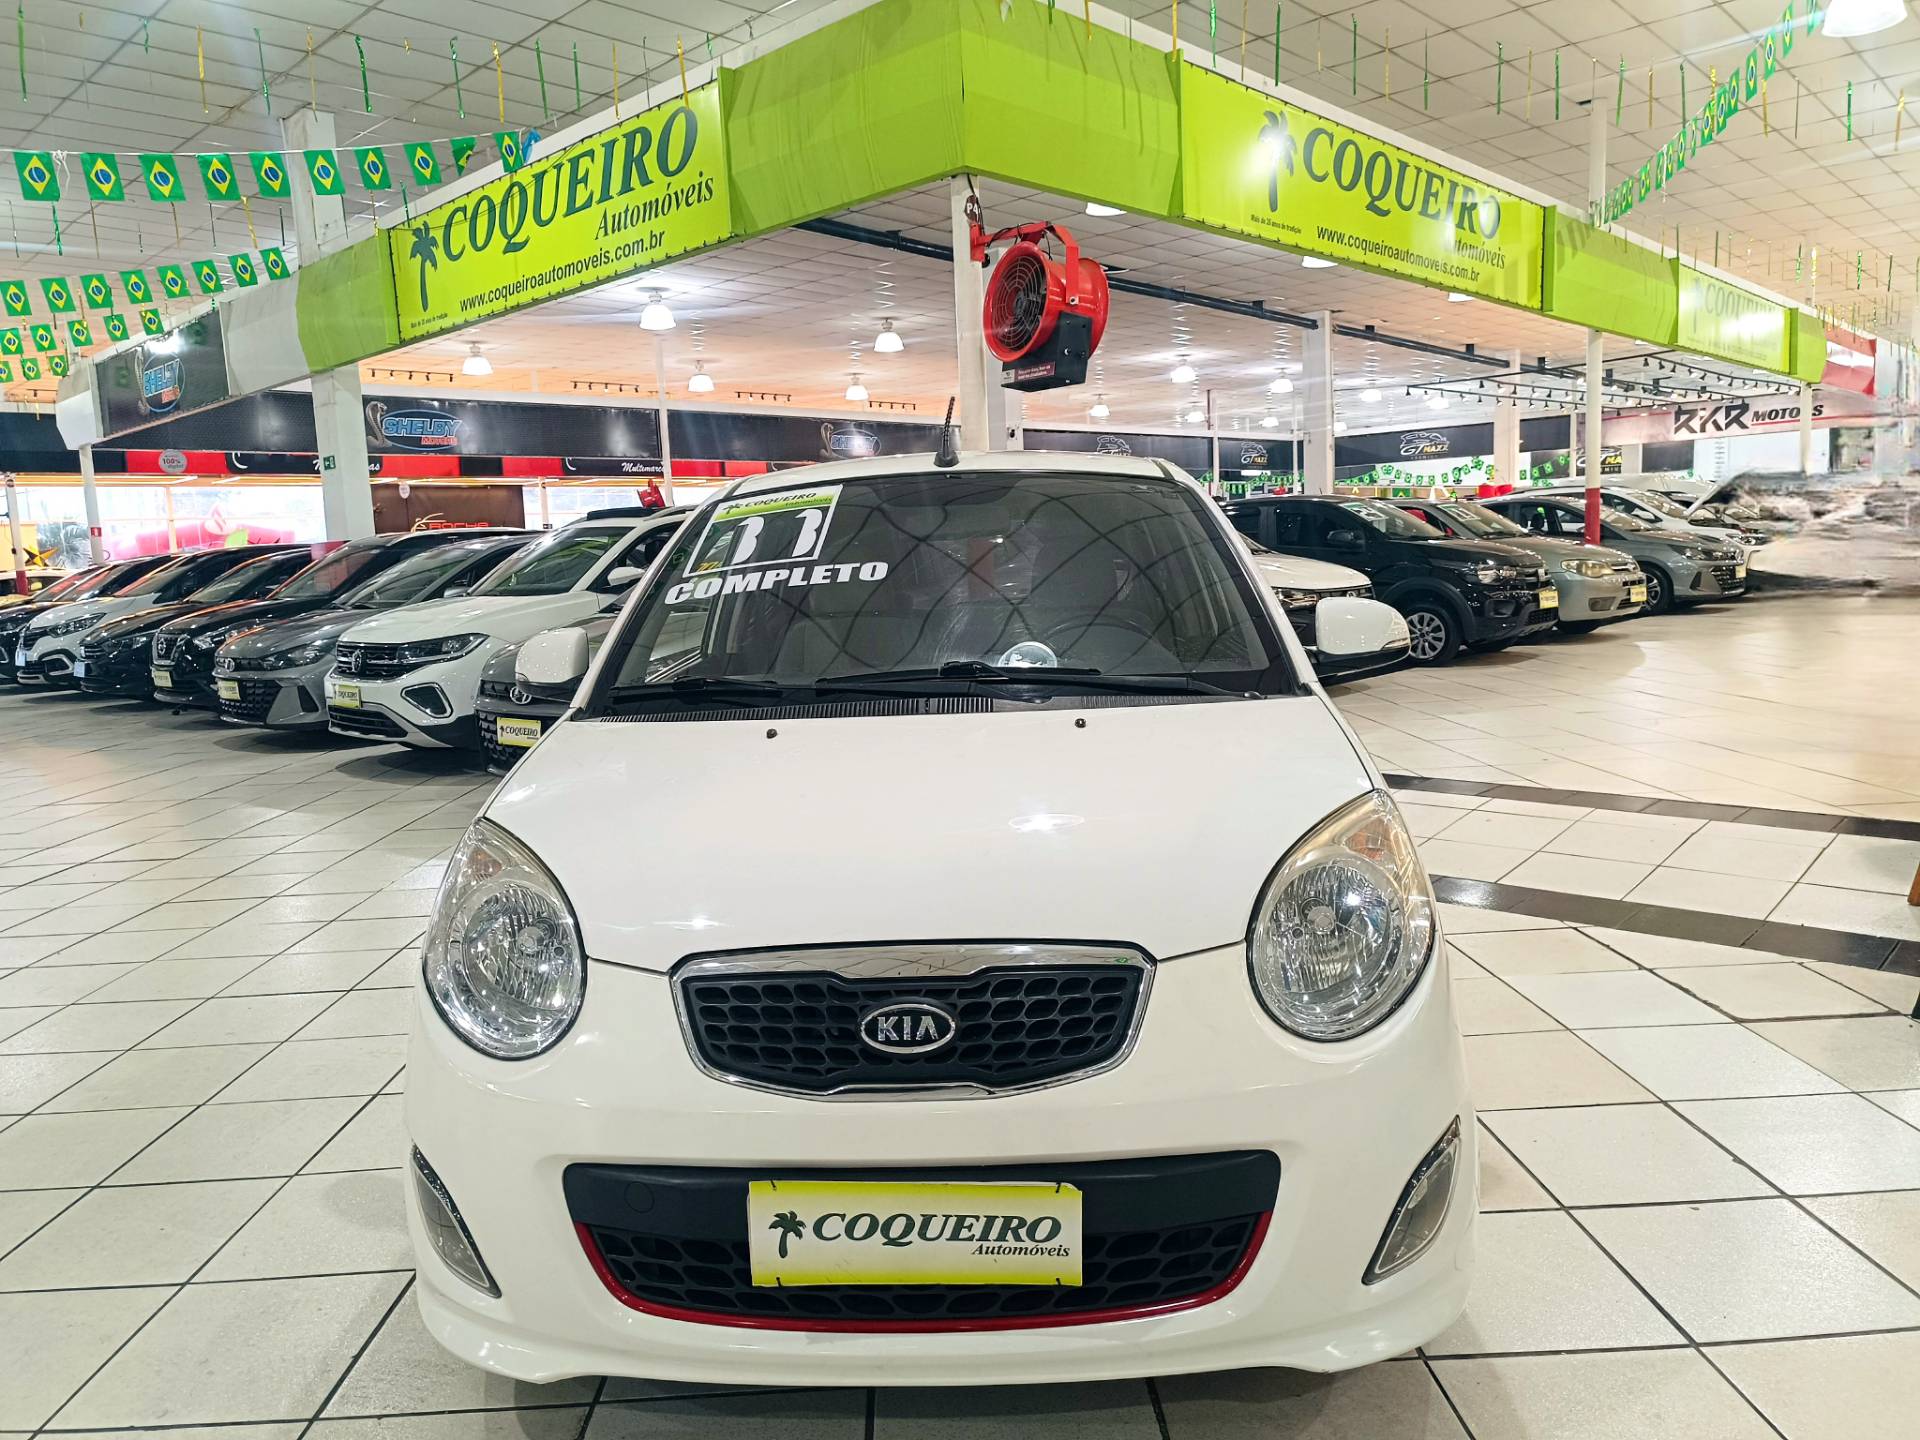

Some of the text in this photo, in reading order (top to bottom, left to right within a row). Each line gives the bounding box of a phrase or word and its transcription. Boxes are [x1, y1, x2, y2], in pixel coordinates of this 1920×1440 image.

[443, 106, 699, 262] COQUEIRO
[1303, 127, 1501, 239] COQUEIRO
[595, 170, 714, 240] Automóveis
[459, 230, 666, 312] www.coqueiroautomoveis.com.br
[1316, 226, 1480, 282] www.coqueiroautomoveis.com.br
[382, 417, 462, 437] SHELBY
[1752, 404, 1824, 423] MOTOS
[744, 492, 817, 507] COQUEIRO
[665, 561, 889, 605] COMPLETO
[505, 725, 538, 737] COQUEIRO
[877, 1015, 939, 1041] KIA
[812, 1213, 1062, 1247] COQUEIRO
[970, 1243, 1071, 1258] Automóveis
